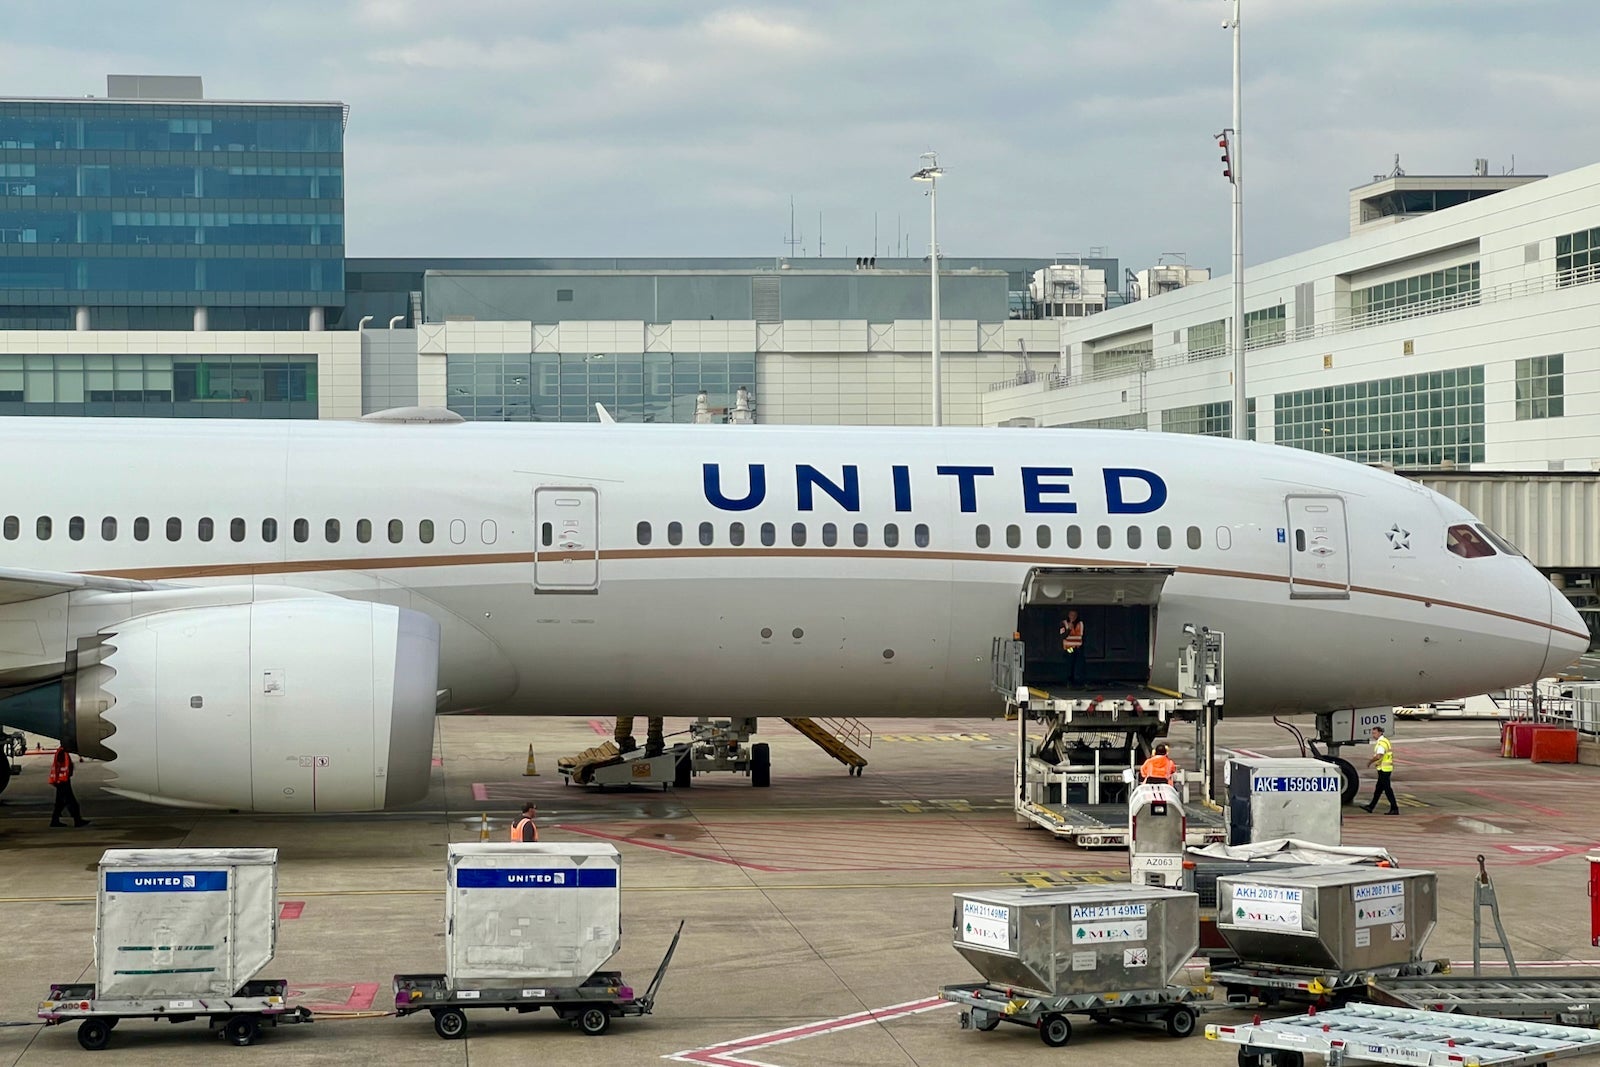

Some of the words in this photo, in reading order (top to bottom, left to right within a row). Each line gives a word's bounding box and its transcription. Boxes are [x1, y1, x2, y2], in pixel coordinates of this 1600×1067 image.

[703, 464, 1167, 514] UNITED
[1361, 714, 1387, 725] 1005
[1256, 777, 1278, 792] AKE
[1284, 777, 1318, 792] 15966
[1320, 777, 1337, 792] UA
[1146, 858, 1173, 866] AZ063
[135, 877, 180, 886] UNITED
[508, 874, 552, 883] UNITED
[1236, 887, 1257, 898] AKH
[1258, 889, 1283, 899] 20871
[1286, 891, 1300, 901] ME
[1356, 887, 1371, 898] AKH
[1372, 885, 1390, 896] 20871
[1391, 883, 1402, 893] ME
[964, 903, 979, 914] AKH
[1073, 907, 1096, 918] AKH
[1366, 908, 1395, 918] MEA
[1248, 912, 1286, 922] MEA
[973, 927, 998, 939] MEA
[1089, 929, 1130, 939] MEA
